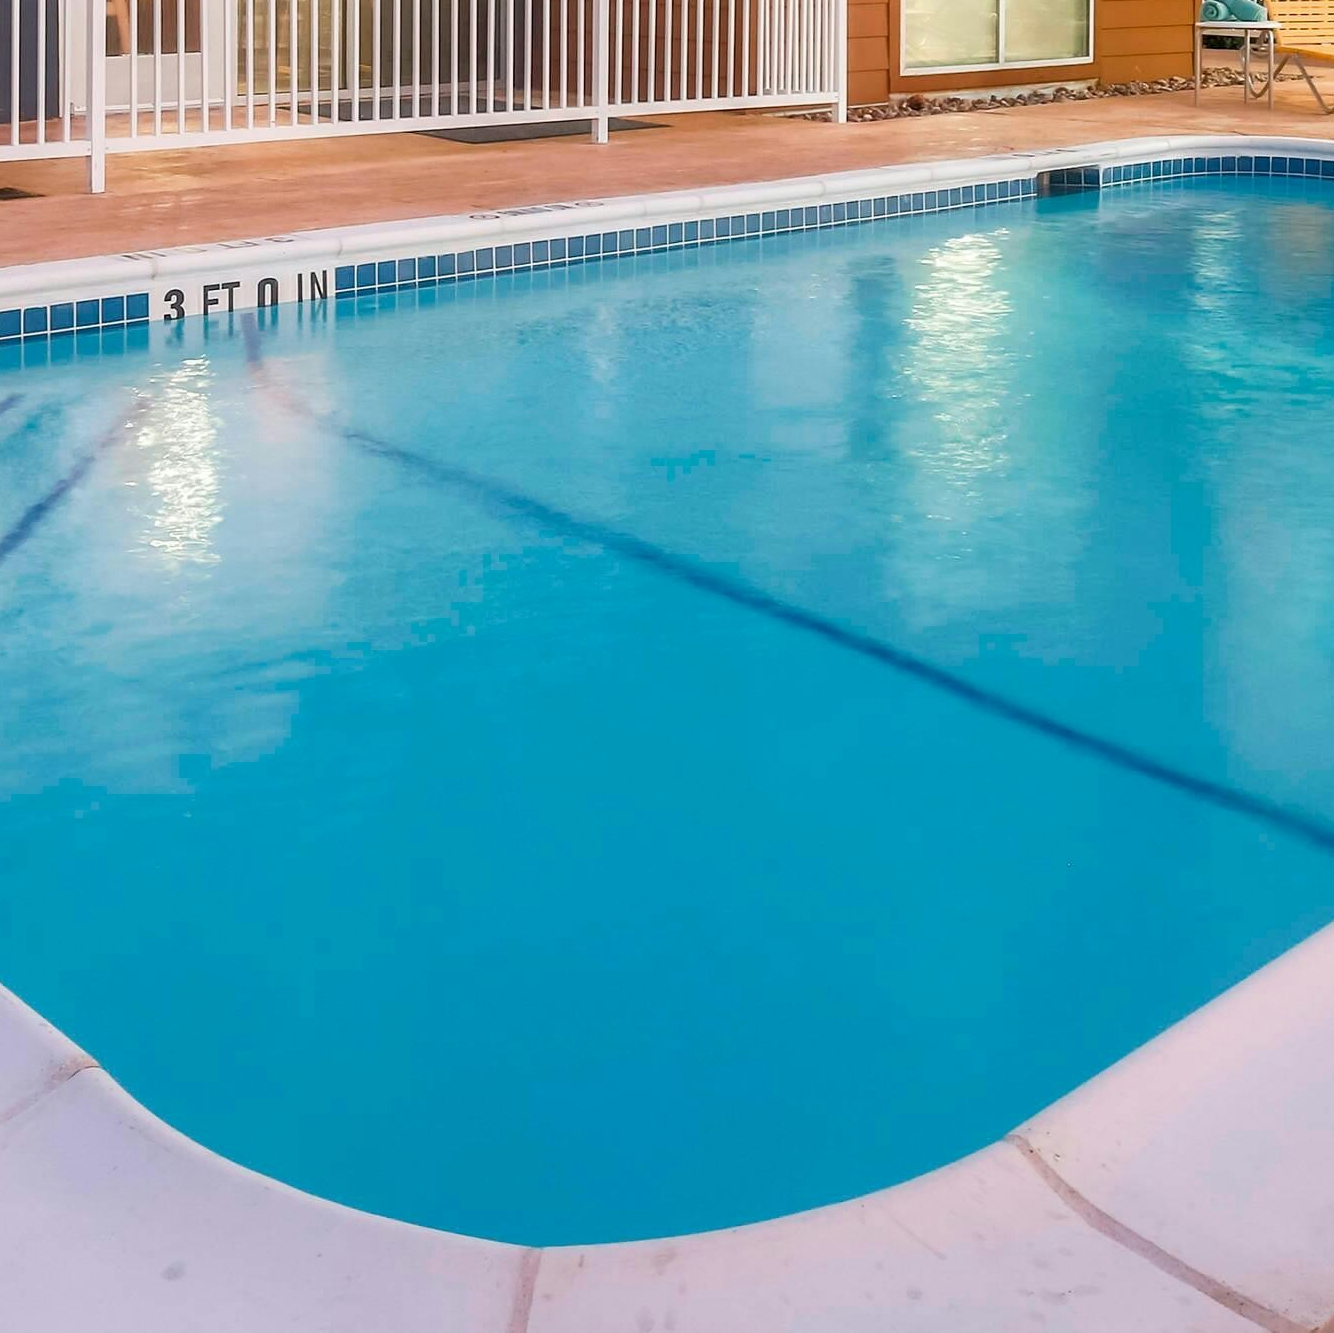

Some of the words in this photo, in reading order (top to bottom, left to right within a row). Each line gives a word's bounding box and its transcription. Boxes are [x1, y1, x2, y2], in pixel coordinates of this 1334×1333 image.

[164, 288, 185, 320] 3
[203, 281, 240, 316] FT
[297, 270, 328, 303] IN
